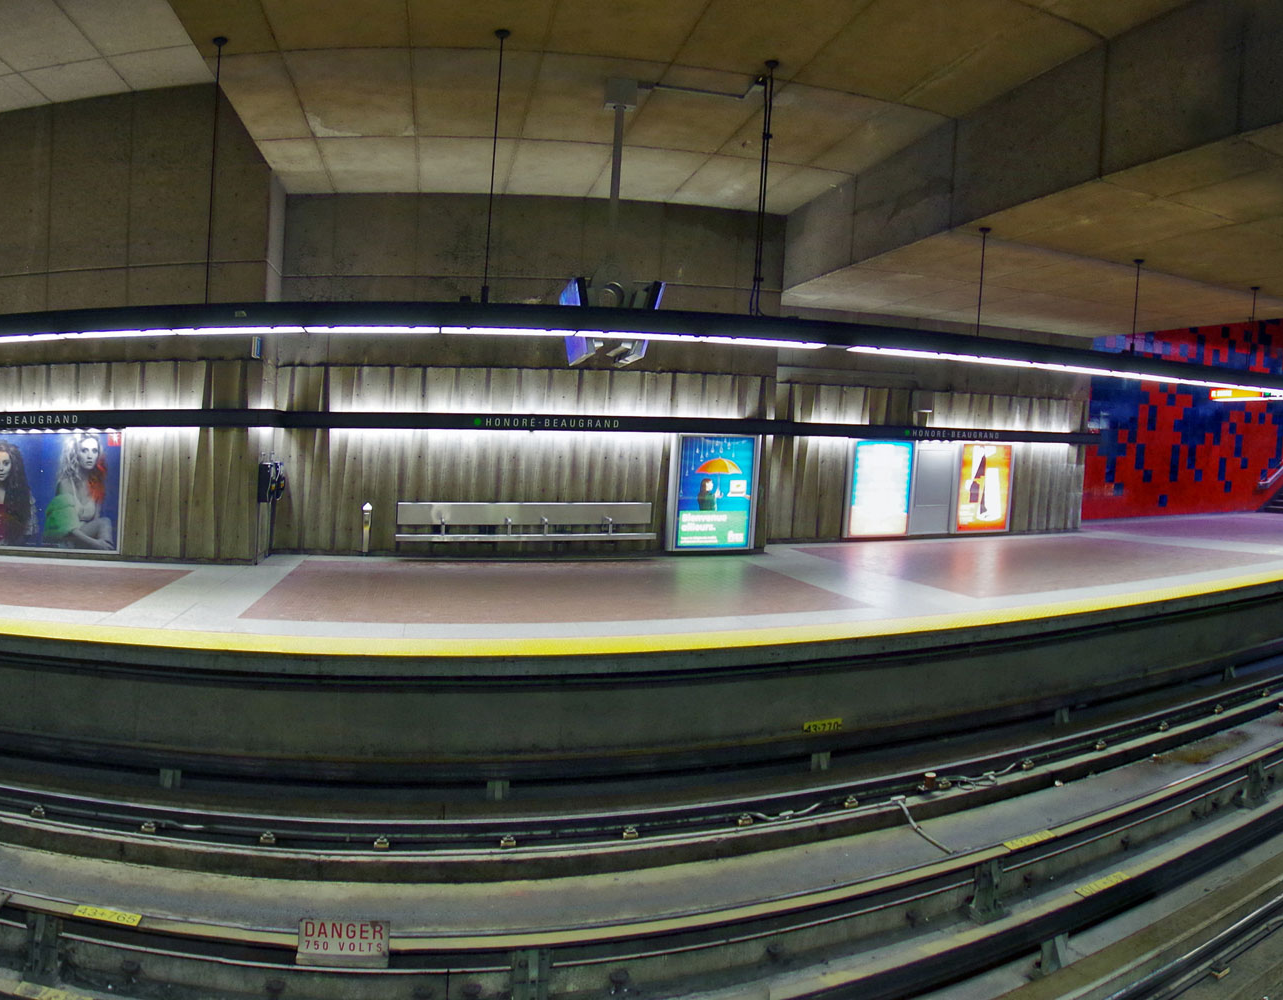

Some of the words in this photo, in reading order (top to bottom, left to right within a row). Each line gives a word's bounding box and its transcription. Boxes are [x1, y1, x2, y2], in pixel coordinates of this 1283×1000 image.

[485, 417, 620, 428] HONORÉ-BEAUGRAND
[912, 429, 1001, 440] HONORÉ-BEAUGRAND
[304, 921, 384, 940] DANGER
[304, 940, 329, 951] 750
[338, 941, 383, 953] VOLTS
